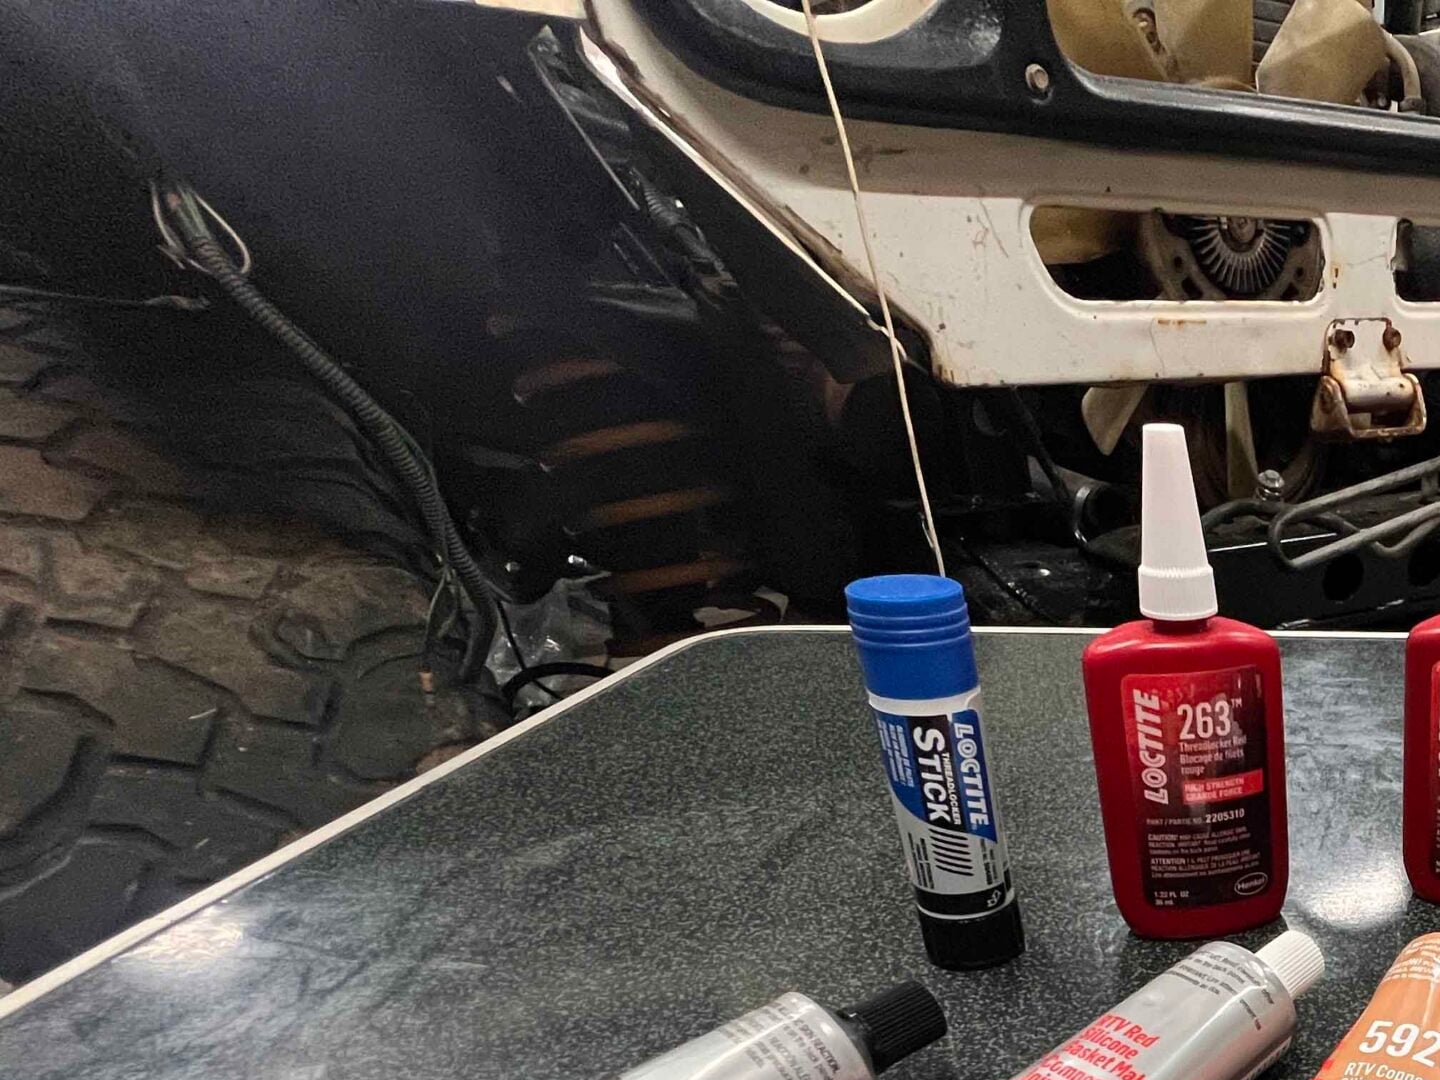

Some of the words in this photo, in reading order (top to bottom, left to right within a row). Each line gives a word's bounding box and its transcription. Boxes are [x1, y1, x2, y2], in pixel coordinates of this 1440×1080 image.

[1133, 688, 1169, 804] LOCTITE
[913, 726, 950, 822] STICK
[943, 752, 961, 825] THREADLOCKER
[954, 722, 989, 826] LOCTITE
[1205, 808, 1245, 823] 2205310
[1081, 1028, 1139, 1060] Silicone
[1123, 1021, 1160, 1048] Red
[1344, 1061, 1376, 1077] RTV
